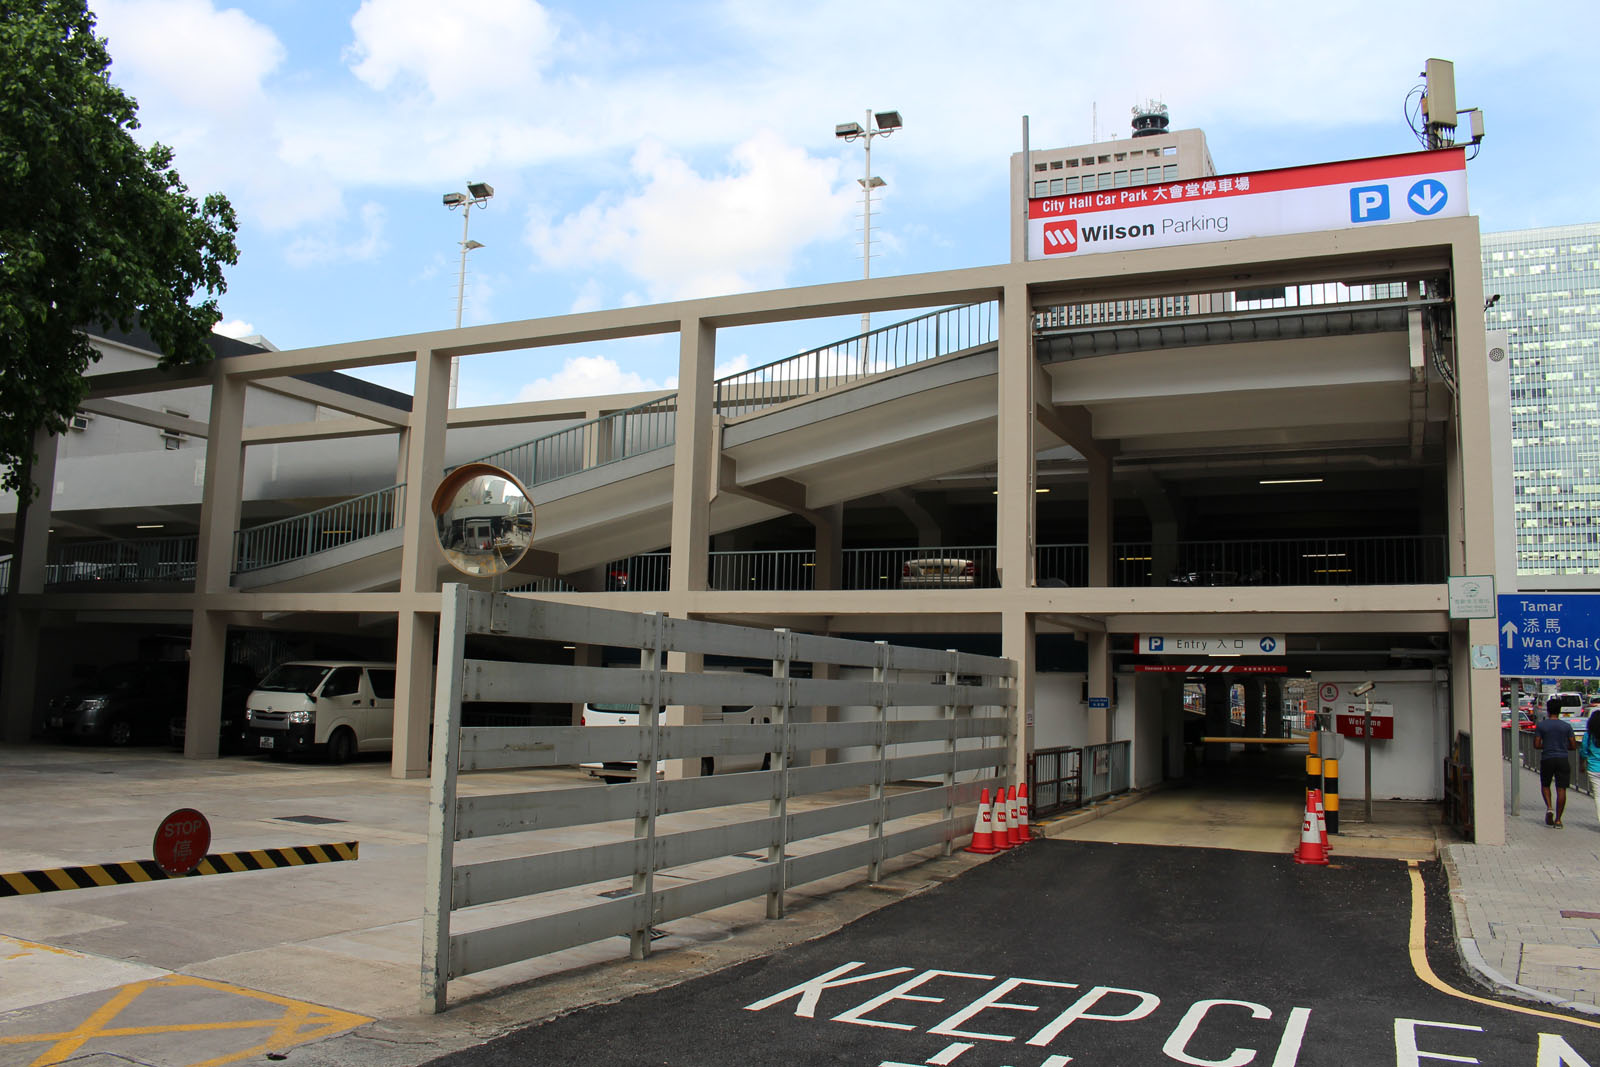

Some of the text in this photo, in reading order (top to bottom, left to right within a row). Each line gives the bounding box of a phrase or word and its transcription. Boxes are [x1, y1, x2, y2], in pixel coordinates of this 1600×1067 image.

[1042, 177, 1250, 213] City Hall Car Park 大會堂停車場
[1358, 191, 1383, 218] P
[1081, 215, 1229, 242] Wilson Parking
[1520, 601, 1563, 612] Tamar
[1523, 618, 1561, 633] 添馬
[1177, 640, 1244, 650] Entry 入口
[1521, 637, 1552, 648] Wan
[1556, 636, 1589, 648] Chai
[1349, 717, 1381, 727] Welcme
[165, 821, 201, 837] STOP
[174, 840, 192, 863] 停
[743, 961, 1163, 1046] KEEP
